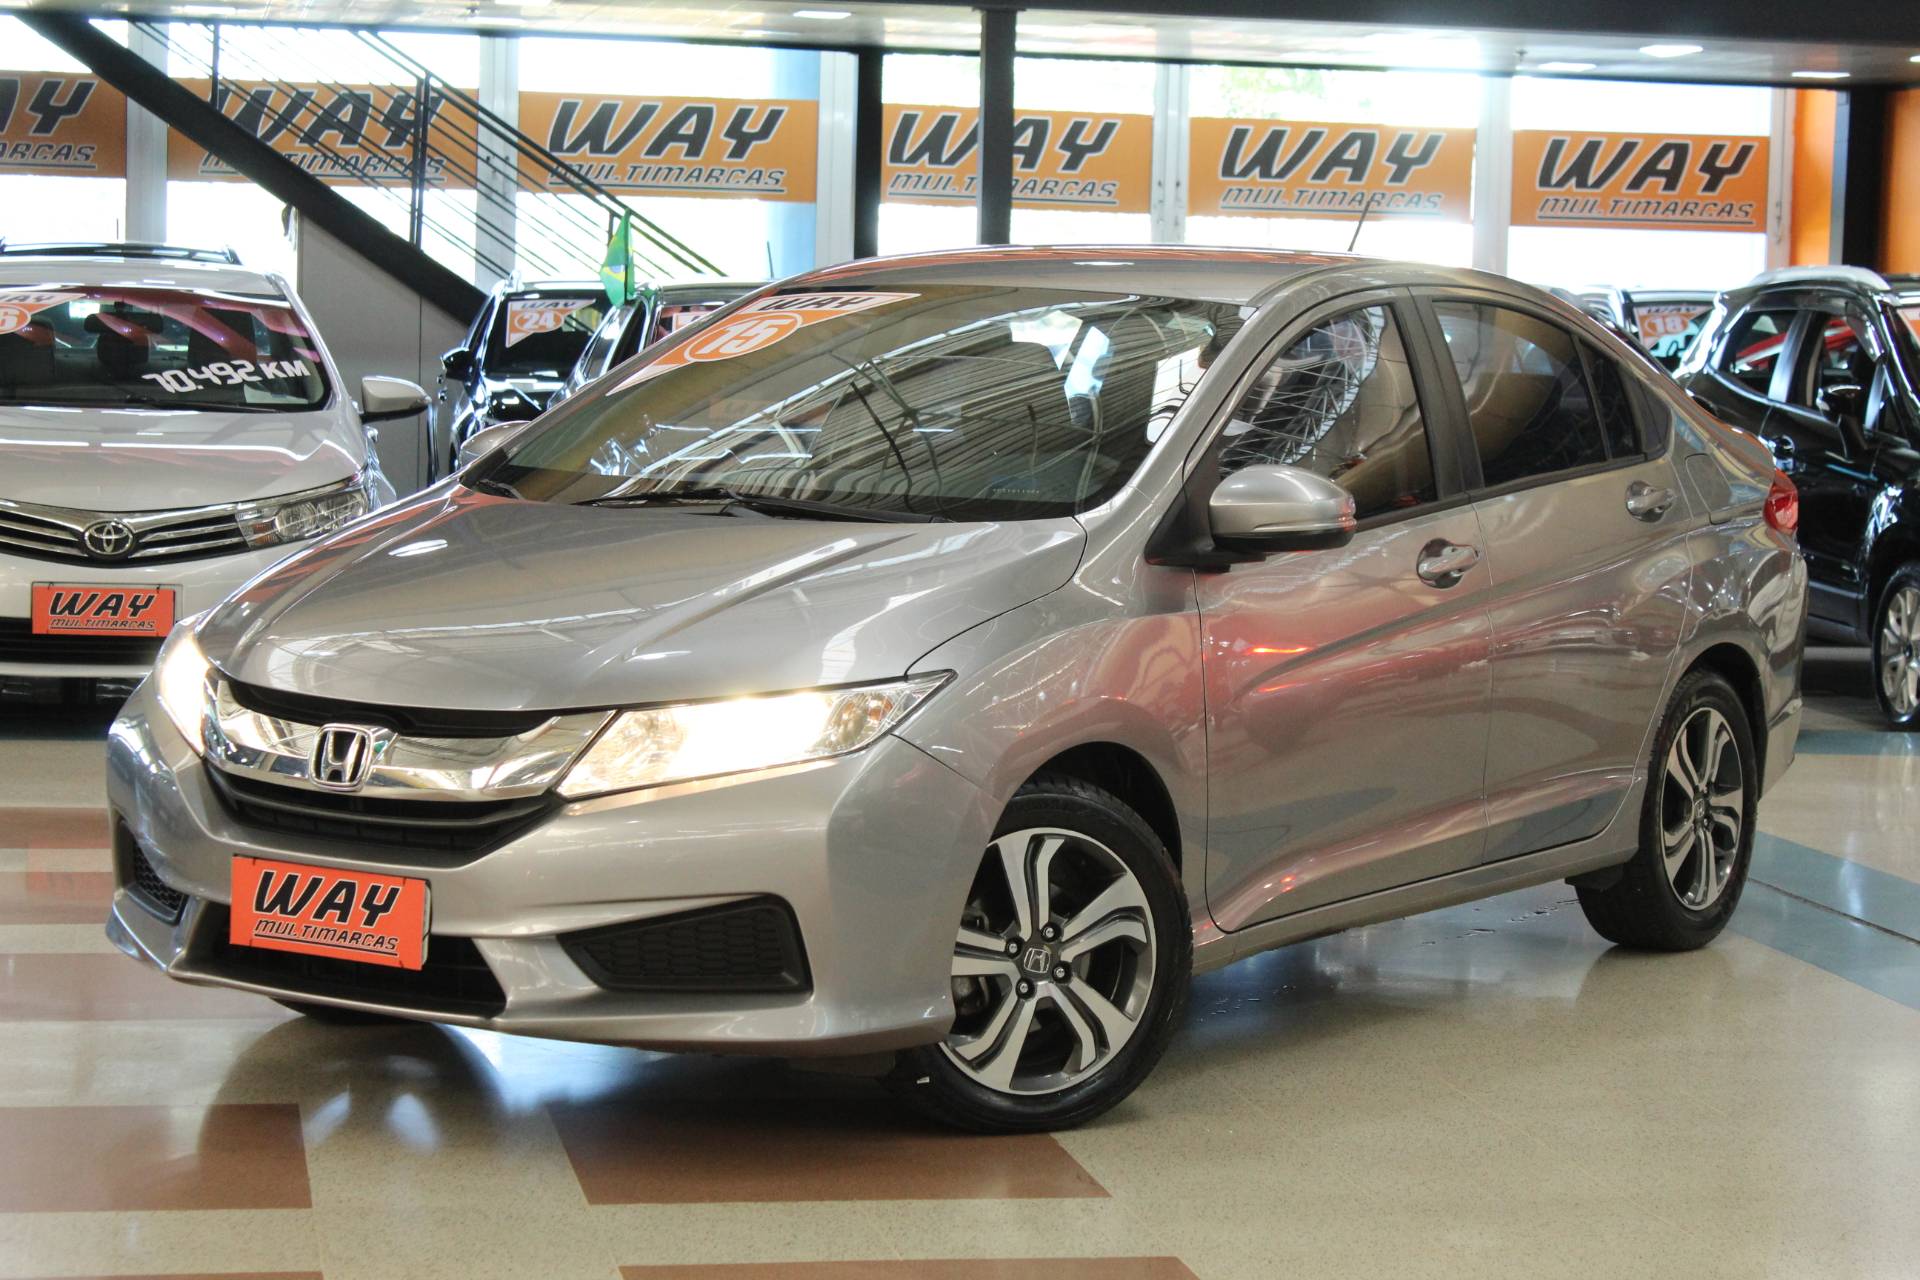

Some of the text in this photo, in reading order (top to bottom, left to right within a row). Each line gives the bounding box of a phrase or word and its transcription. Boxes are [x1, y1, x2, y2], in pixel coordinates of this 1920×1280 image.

[549, 99, 788, 161] WAY
[887, 110, 1121, 173] WAY
[1219, 126, 1446, 185] WAY
[1536, 136, 1758, 194] WAY
[1221, 187, 1442, 210] MULTIMARCAS
[1538, 198, 1754, 218] MULTIMARCAS
[758, 296, 877, 311] WAY
[523, 310, 556, 331] 24
[696, 319, 790, 355] 15
[259, 360, 311, 380] KM
[48, 591, 157, 619] WAY
[50, 618, 155, 630] MULTIMARCAS
[253, 869, 402, 929] WAY
[255, 918, 399, 950] MULTIMARCAS
